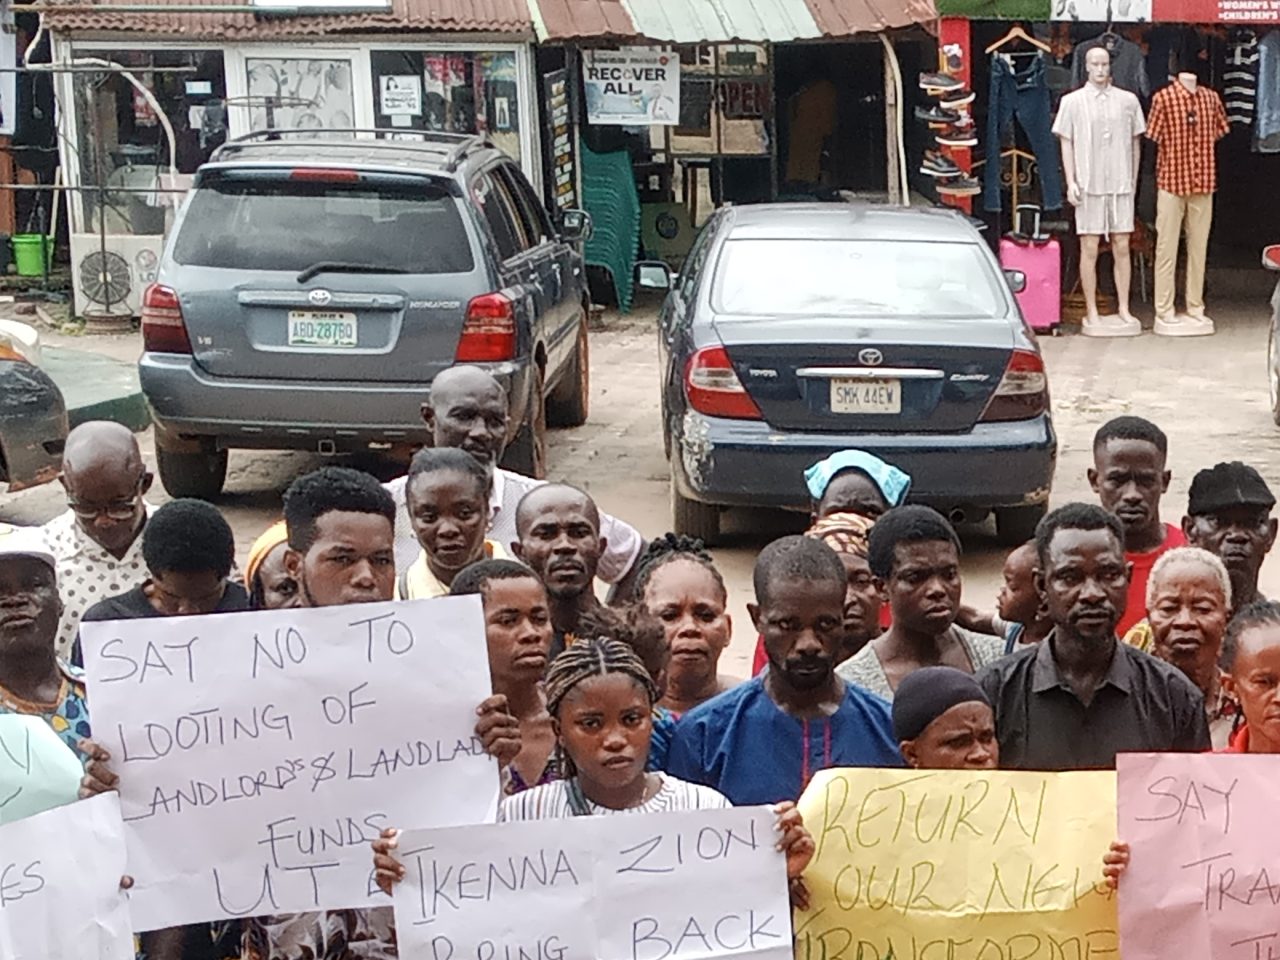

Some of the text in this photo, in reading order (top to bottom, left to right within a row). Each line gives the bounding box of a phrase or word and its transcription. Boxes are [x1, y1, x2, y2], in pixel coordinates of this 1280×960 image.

[603, 82, 638, 95] ALL
[99, 611, 414, 684] SAY NO TO
[118, 682, 376, 764] LOOTING OF
[347, 735, 493, 780] LANDLAD
[815, 773, 1047, 863] RETURN
[1134, 776, 1239, 834] SAY
[402, 819, 759, 926] IKENNA ZION
[834, 861, 941, 919] OUR
